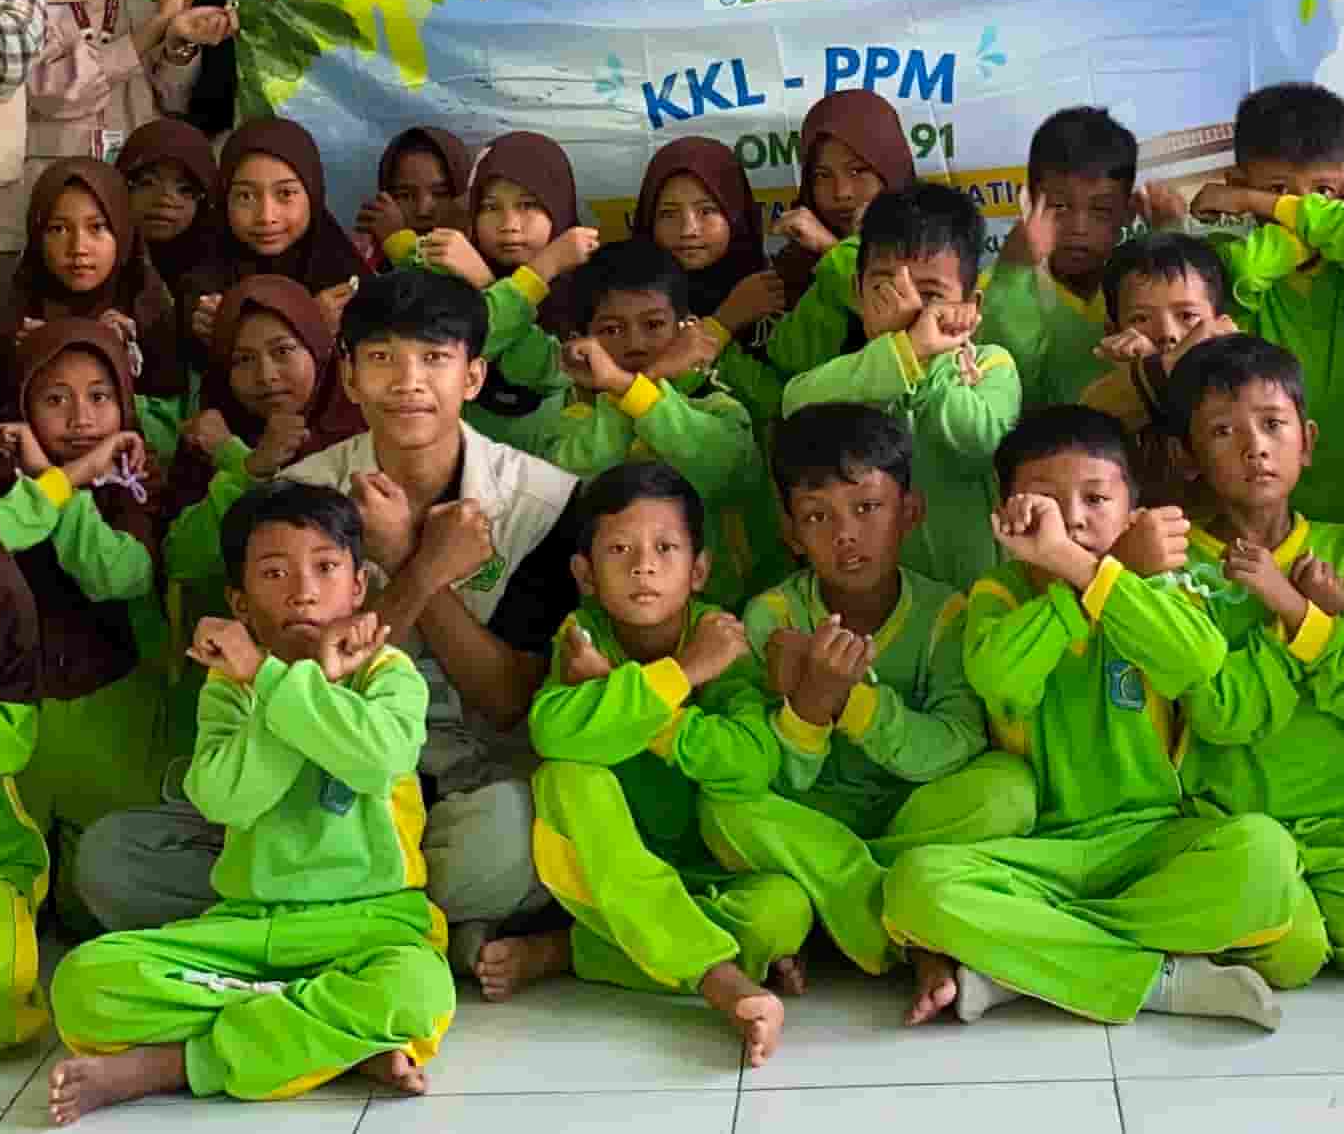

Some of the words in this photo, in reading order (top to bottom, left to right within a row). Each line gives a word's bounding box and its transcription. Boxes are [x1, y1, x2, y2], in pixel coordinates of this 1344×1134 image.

[641, 57, 766, 130] KKL
[784, 76, 804, 89] -
[824, 46, 957, 104] PPM
[910, 122, 954, 159] 91
